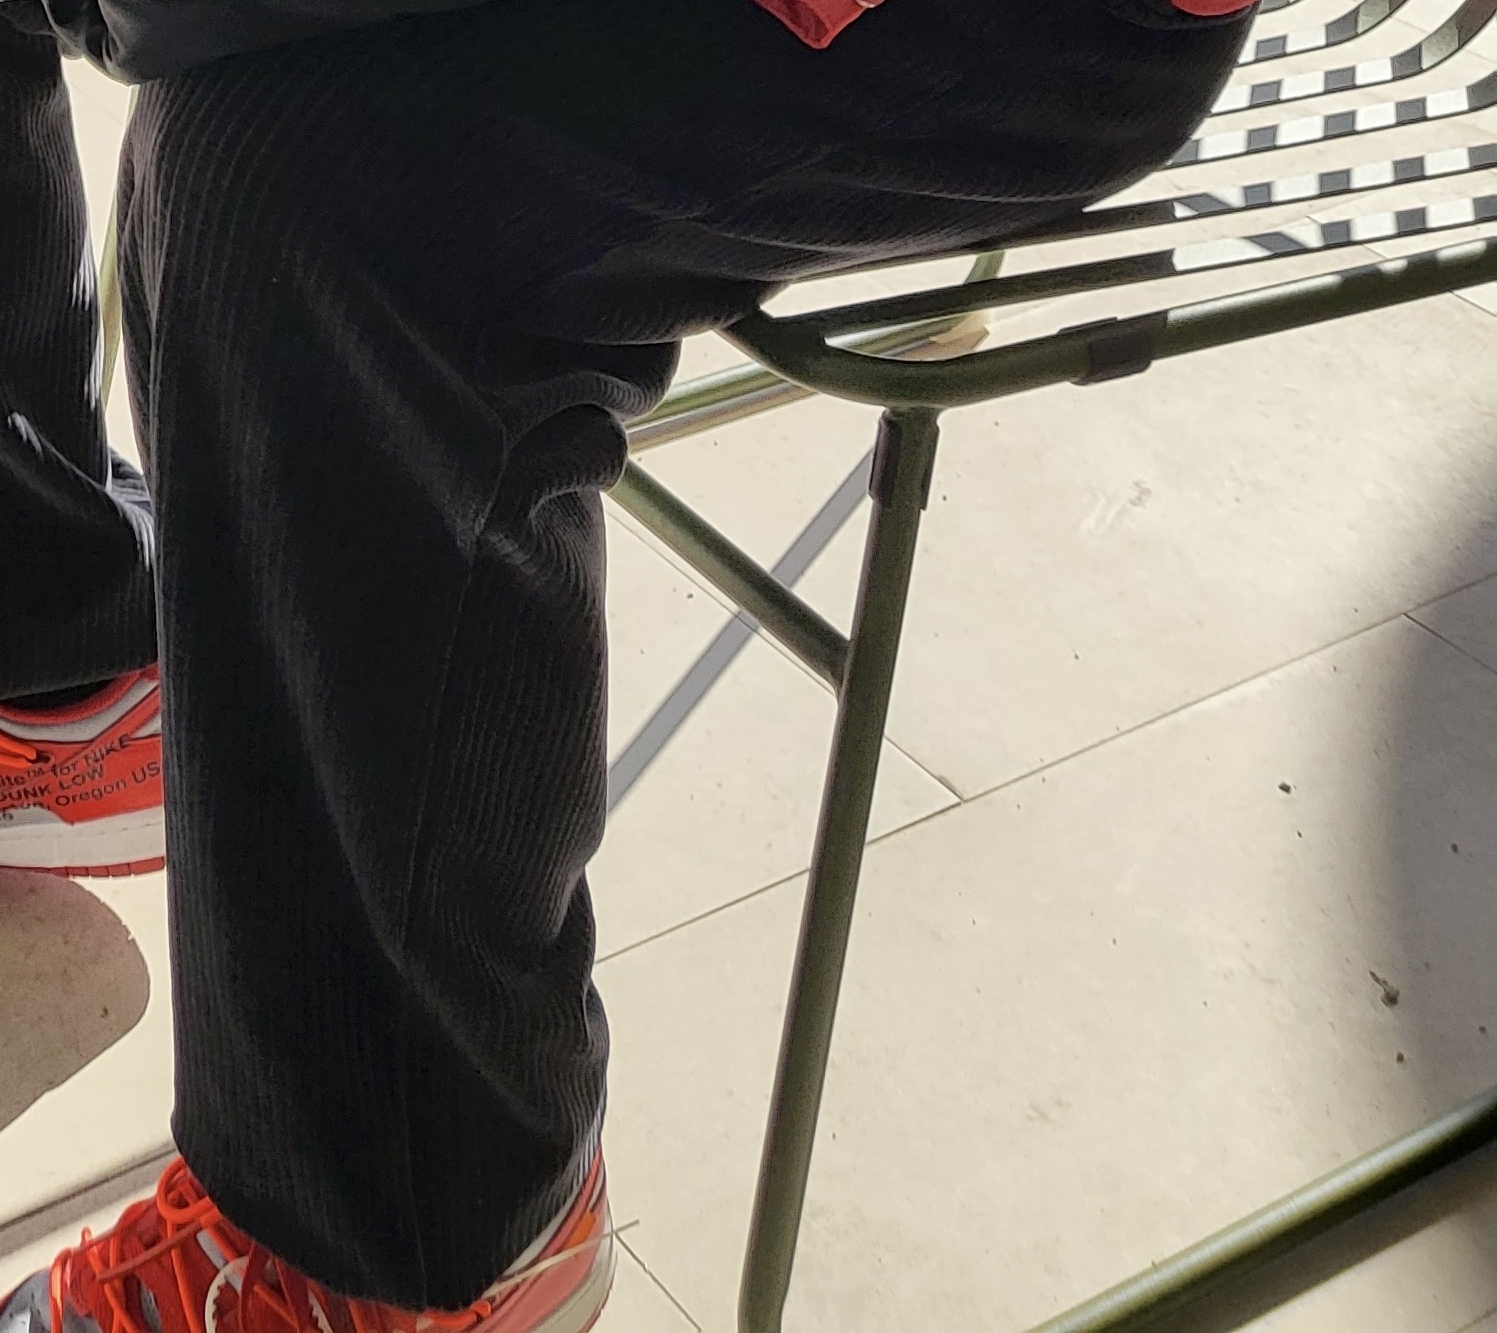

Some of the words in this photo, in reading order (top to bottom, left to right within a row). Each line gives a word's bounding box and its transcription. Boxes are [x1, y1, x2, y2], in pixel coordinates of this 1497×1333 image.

[50, 760, 78, 779] for
[83, 733, 133, 767] NIKE
[58, 762, 105, 791] LOW
[55, 778, 128, 807] Oregon
